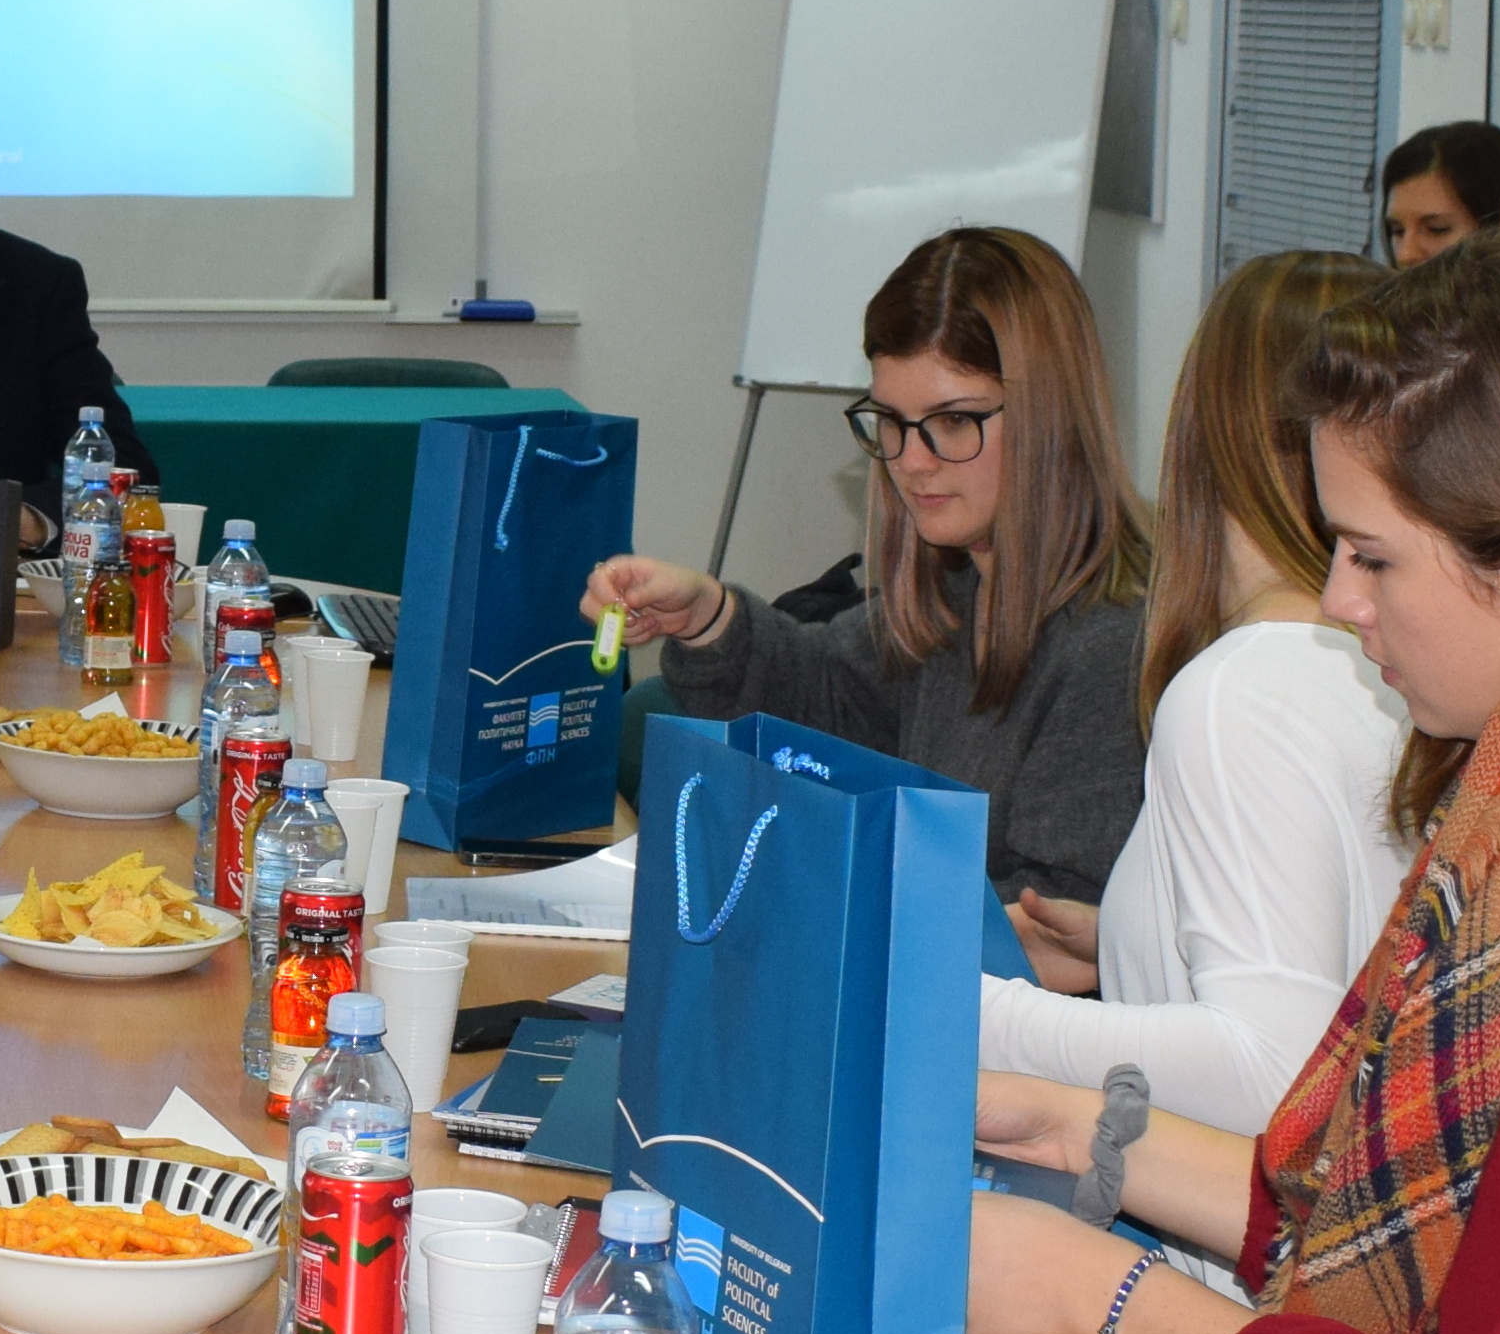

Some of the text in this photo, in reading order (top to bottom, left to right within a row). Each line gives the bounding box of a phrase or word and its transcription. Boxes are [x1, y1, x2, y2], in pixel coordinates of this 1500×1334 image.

[226, 750, 285, 760] ORIGINAL TASTE
[525, 748, 556, 765] ФПН
[295, 907, 364, 918] ORIGINAL TASTE
[727, 1256, 779, 1299] FACULTY of
[724, 1280, 772, 1322] POLITICAL
